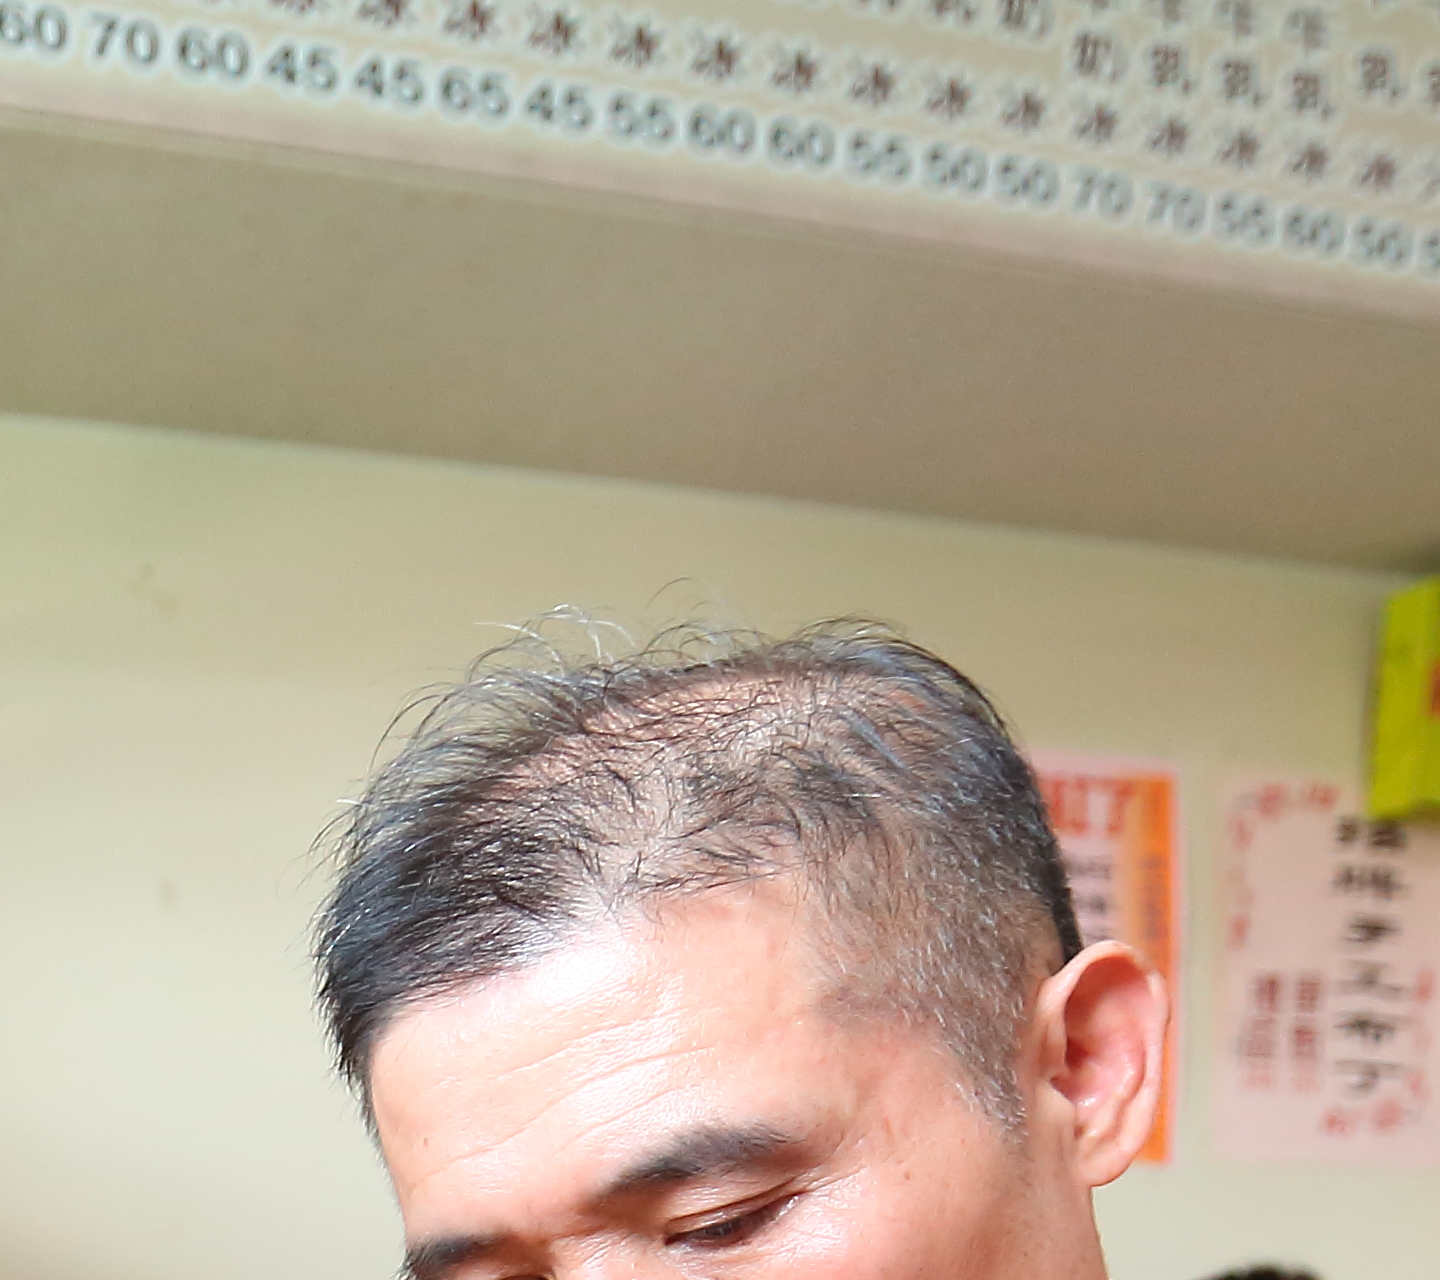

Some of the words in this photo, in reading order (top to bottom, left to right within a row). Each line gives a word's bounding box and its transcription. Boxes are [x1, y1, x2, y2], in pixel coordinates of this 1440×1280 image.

[87, 9, 161, 66] 70
[175, 24, 251, 79] 60
[265, 42, 340, 93] 45
[352, 54, 426, 106] 45
[438, 64, 510, 116] 65
[524, 78, 595, 130] 45
[608, 90, 676, 143] 55
[687, 102, 757, 155] 60
[766, 114, 836, 168] 60
